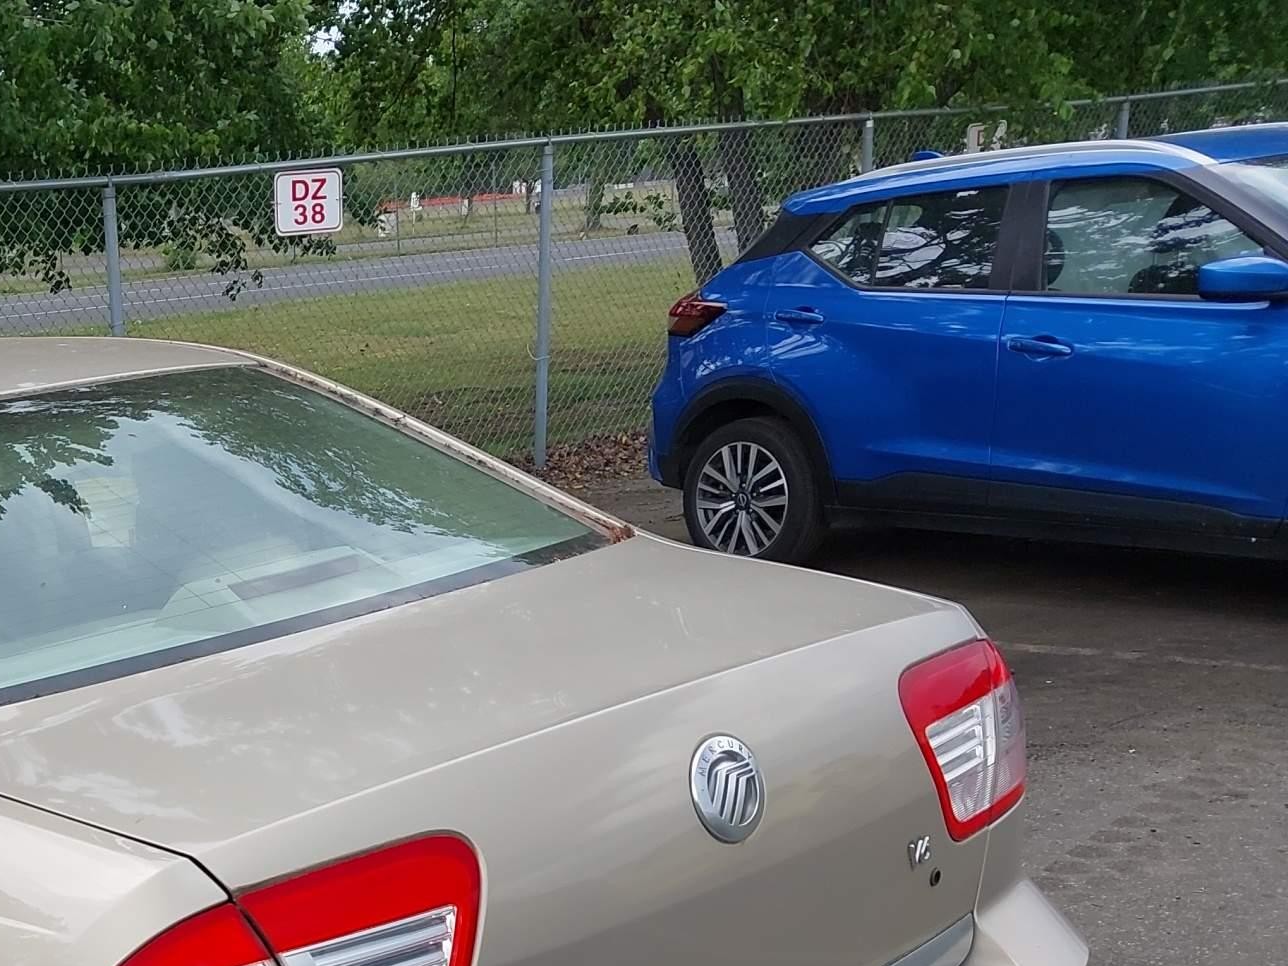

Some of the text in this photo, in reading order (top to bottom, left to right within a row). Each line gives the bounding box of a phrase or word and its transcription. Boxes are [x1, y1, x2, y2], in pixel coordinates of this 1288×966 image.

[292, 178, 327, 201] DZ
[294, 203, 325, 225] 38
[696, 739, 753, 777] MERCURY
